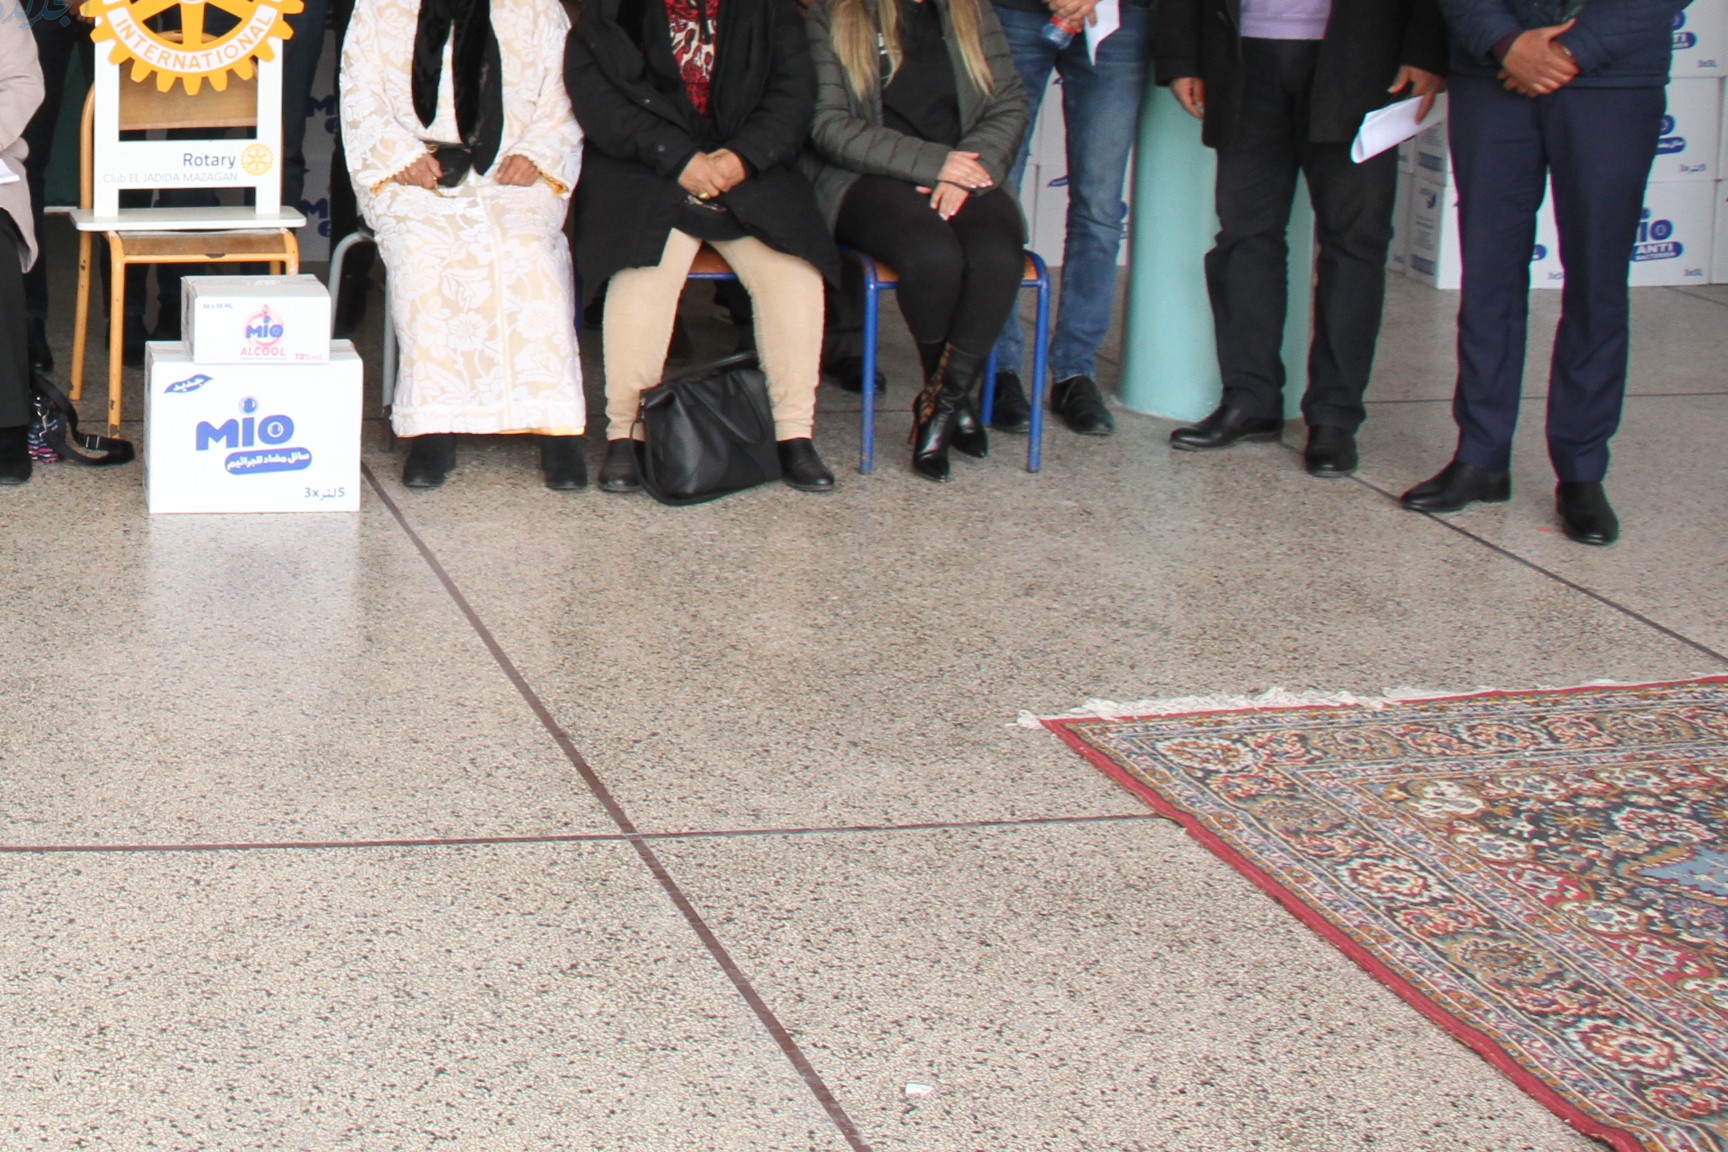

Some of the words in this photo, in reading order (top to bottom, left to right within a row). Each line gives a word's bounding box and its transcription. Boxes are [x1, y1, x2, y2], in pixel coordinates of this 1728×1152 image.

[115, 14, 272, 70] INTERNATIONAL
[183, 153, 236, 169] Rotary
[103, 173, 126, 184] Club
[129, 173, 141, 183] EL
[143, 172, 180, 183] JADIDA
[183, 171, 238, 182] MAZAGAN
[240, 347, 286, 357] ALCOOL
[173, 378, 204, 392] جديد
[227, 455, 262, 470] للجراثيم
[264, 454, 287, 465] مضاد
[288, 451, 310, 465] سائل
